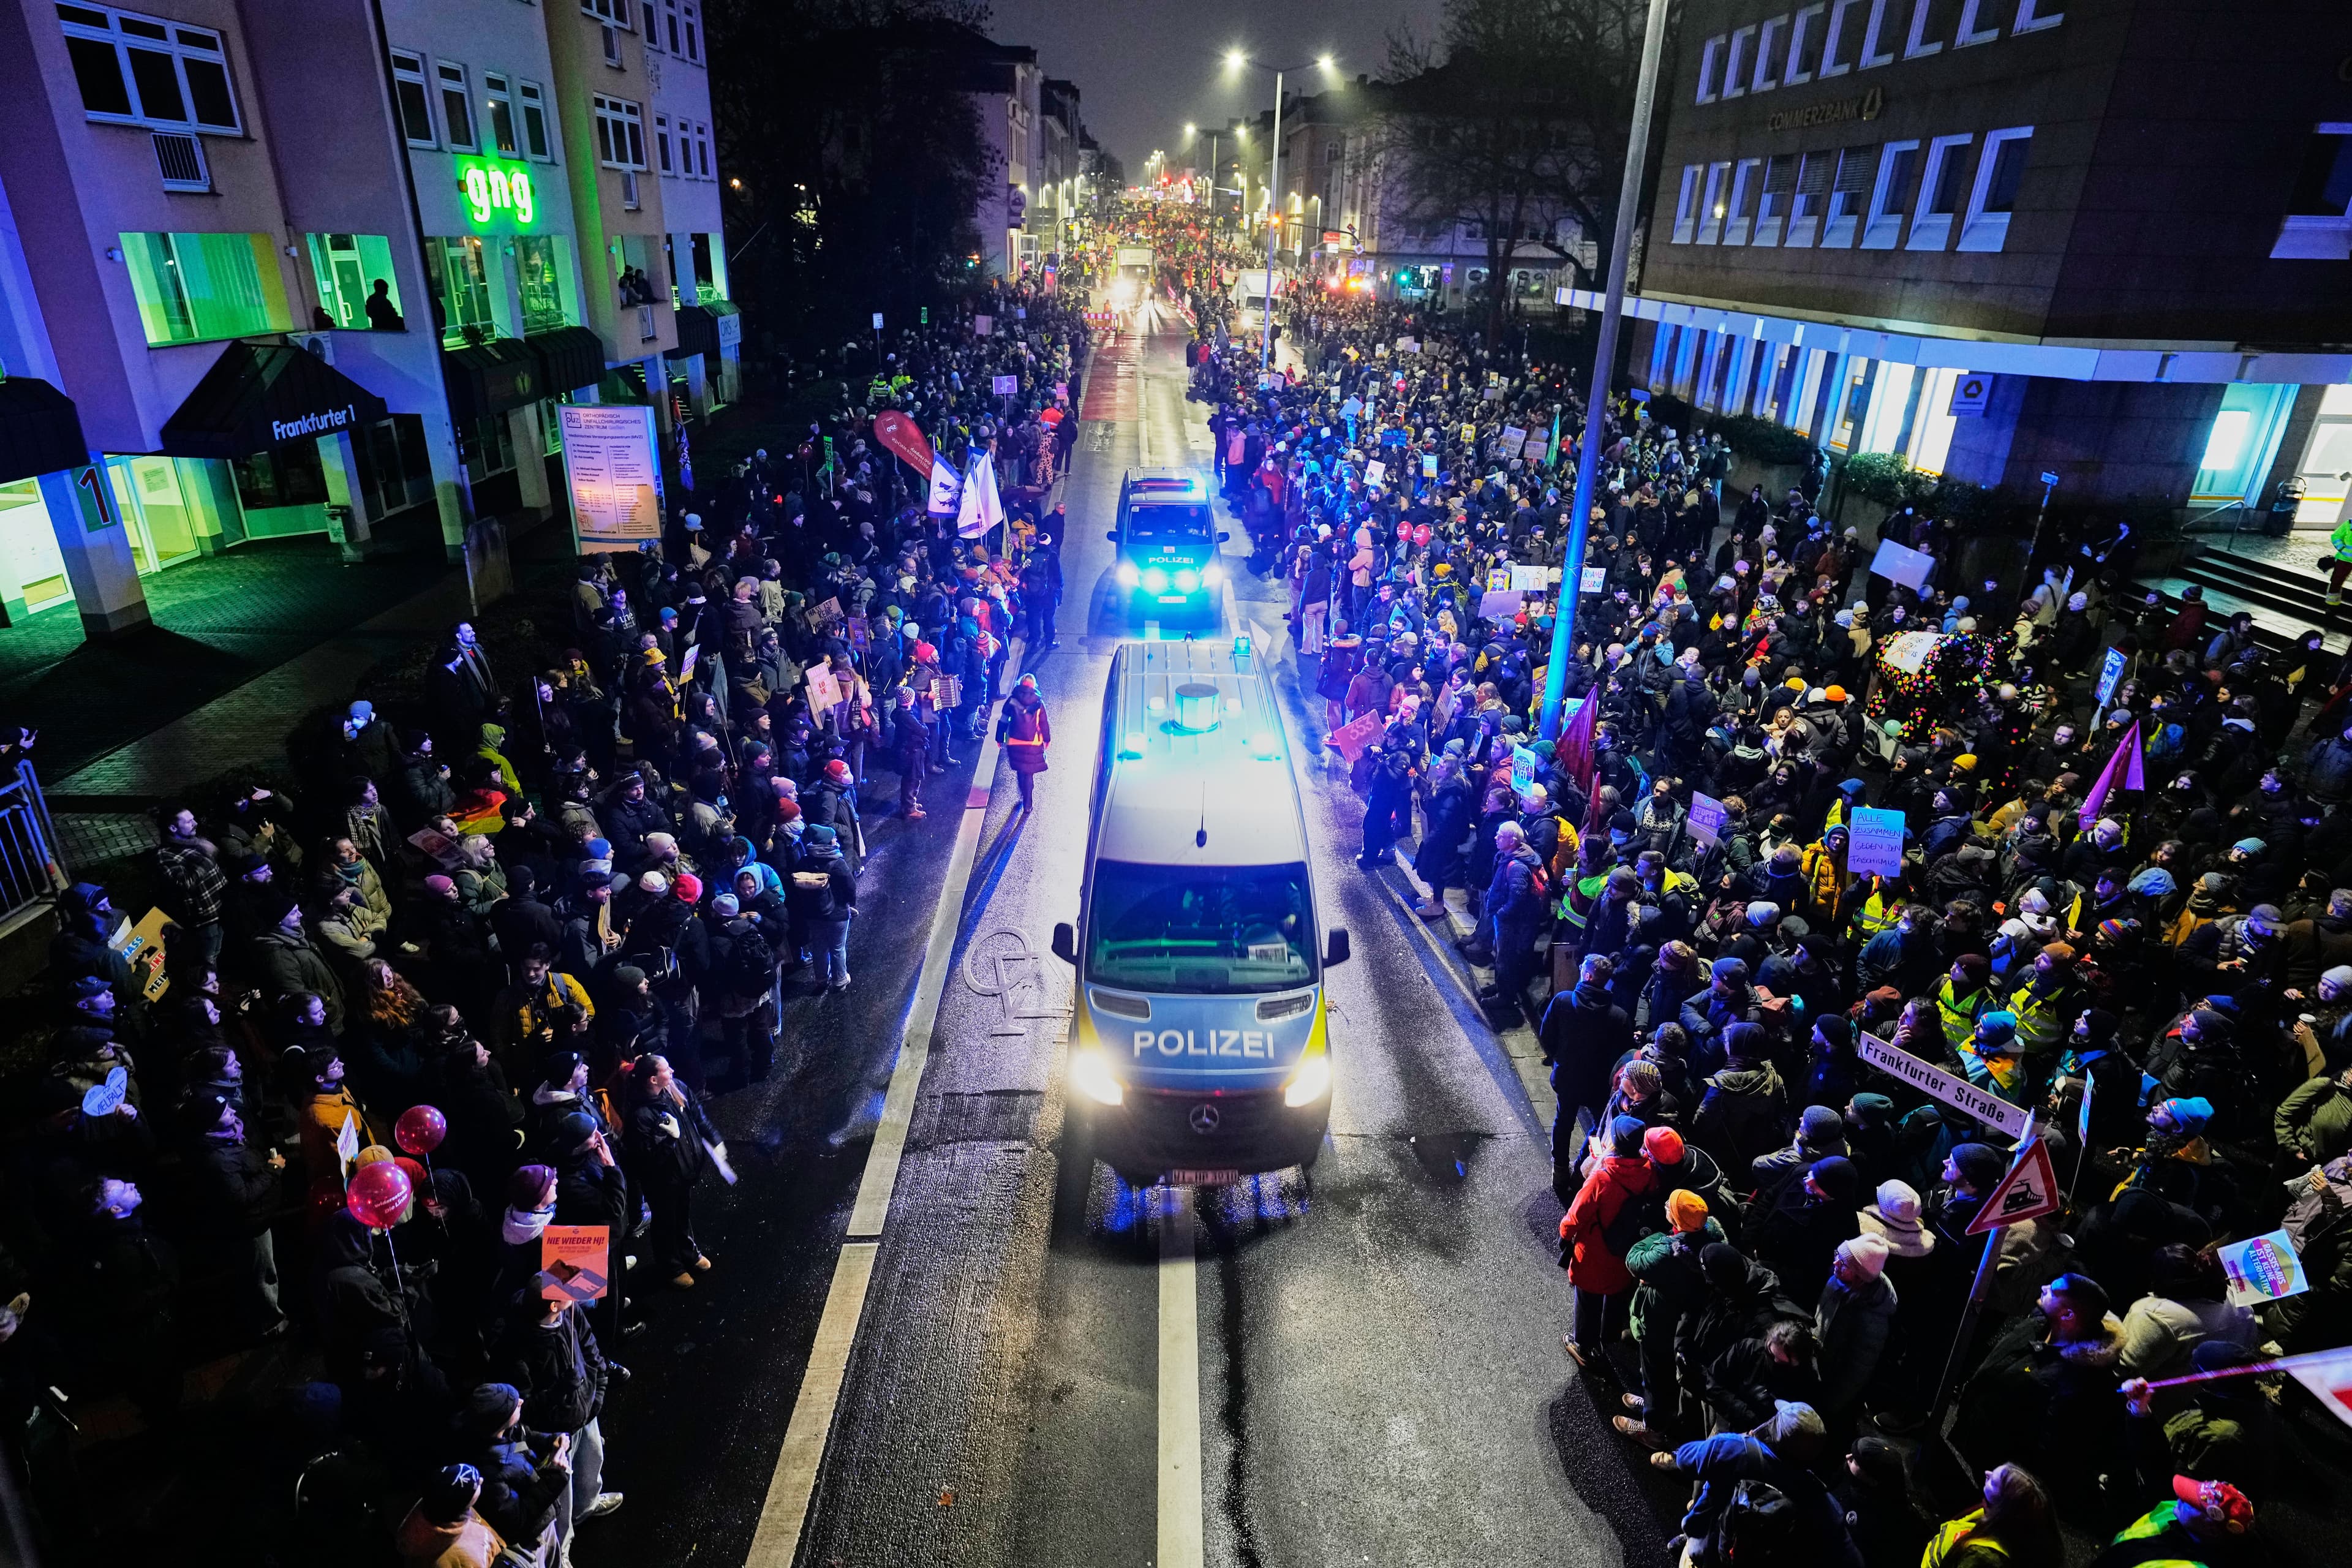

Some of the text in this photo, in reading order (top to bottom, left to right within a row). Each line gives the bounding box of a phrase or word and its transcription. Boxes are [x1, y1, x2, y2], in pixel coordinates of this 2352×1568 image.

[1768, 98, 1860, 130] COMMERZBANK
[466, 168, 532, 223] gng
[273, 404, 355, 440] Frankfurter 1
[78, 466, 111, 525] 1
[809, 600, 832, 617] HASS IST
[1346, 715, 1374, 741] 353
[1692, 813, 1703, 823] DIE
[1694, 805, 1717, 818] STOPPT
[1857, 812, 1885, 823] ALLE
[1854, 826, 1901, 837] ZUSAMMEN
[1855, 842, 1883, 851] GEGEN
[1850, 855, 1897, 867] FASCHISMUS
[123, 936, 144, 960] HASS
[1134, 1029, 1275, 1060] POLIZEI
[1865, 1041, 2005, 1123] Frankfurter Straße
[92, 1080, 124, 1115] VIELFALT
[385, 1205, 395, 1215] Die
[592, 1237, 605, 1246] HJ!
[2248, 1250, 2272, 1294] ALTERNATIVE
[2256, 1248, 2276, 1282] IST KEINE
[2263, 1243, 2286, 1285] RASSISMUS
